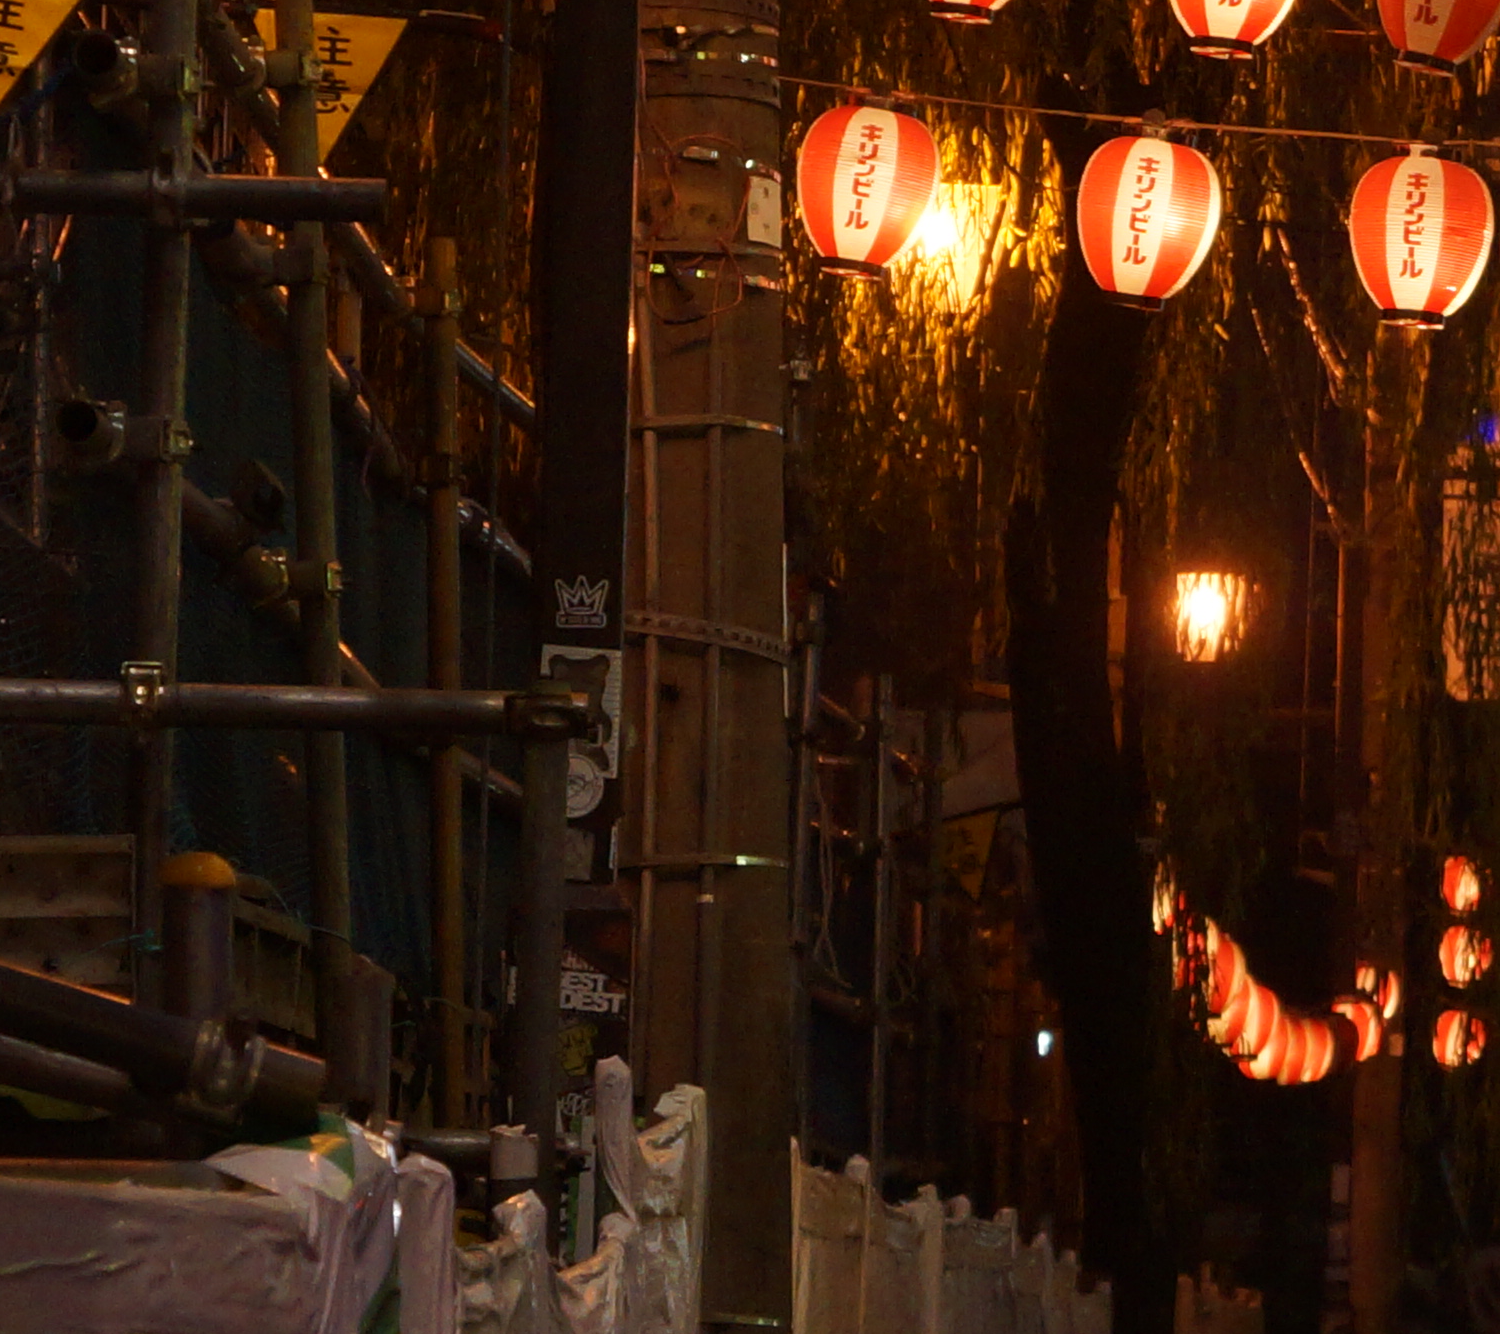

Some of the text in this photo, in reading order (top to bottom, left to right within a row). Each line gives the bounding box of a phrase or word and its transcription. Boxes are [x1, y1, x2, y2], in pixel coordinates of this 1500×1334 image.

[846, 124, 884, 230] キリンビール
[1124, 157, 1159, 265] キリンビール
[1401, 172, 1430, 278] キリンビール
